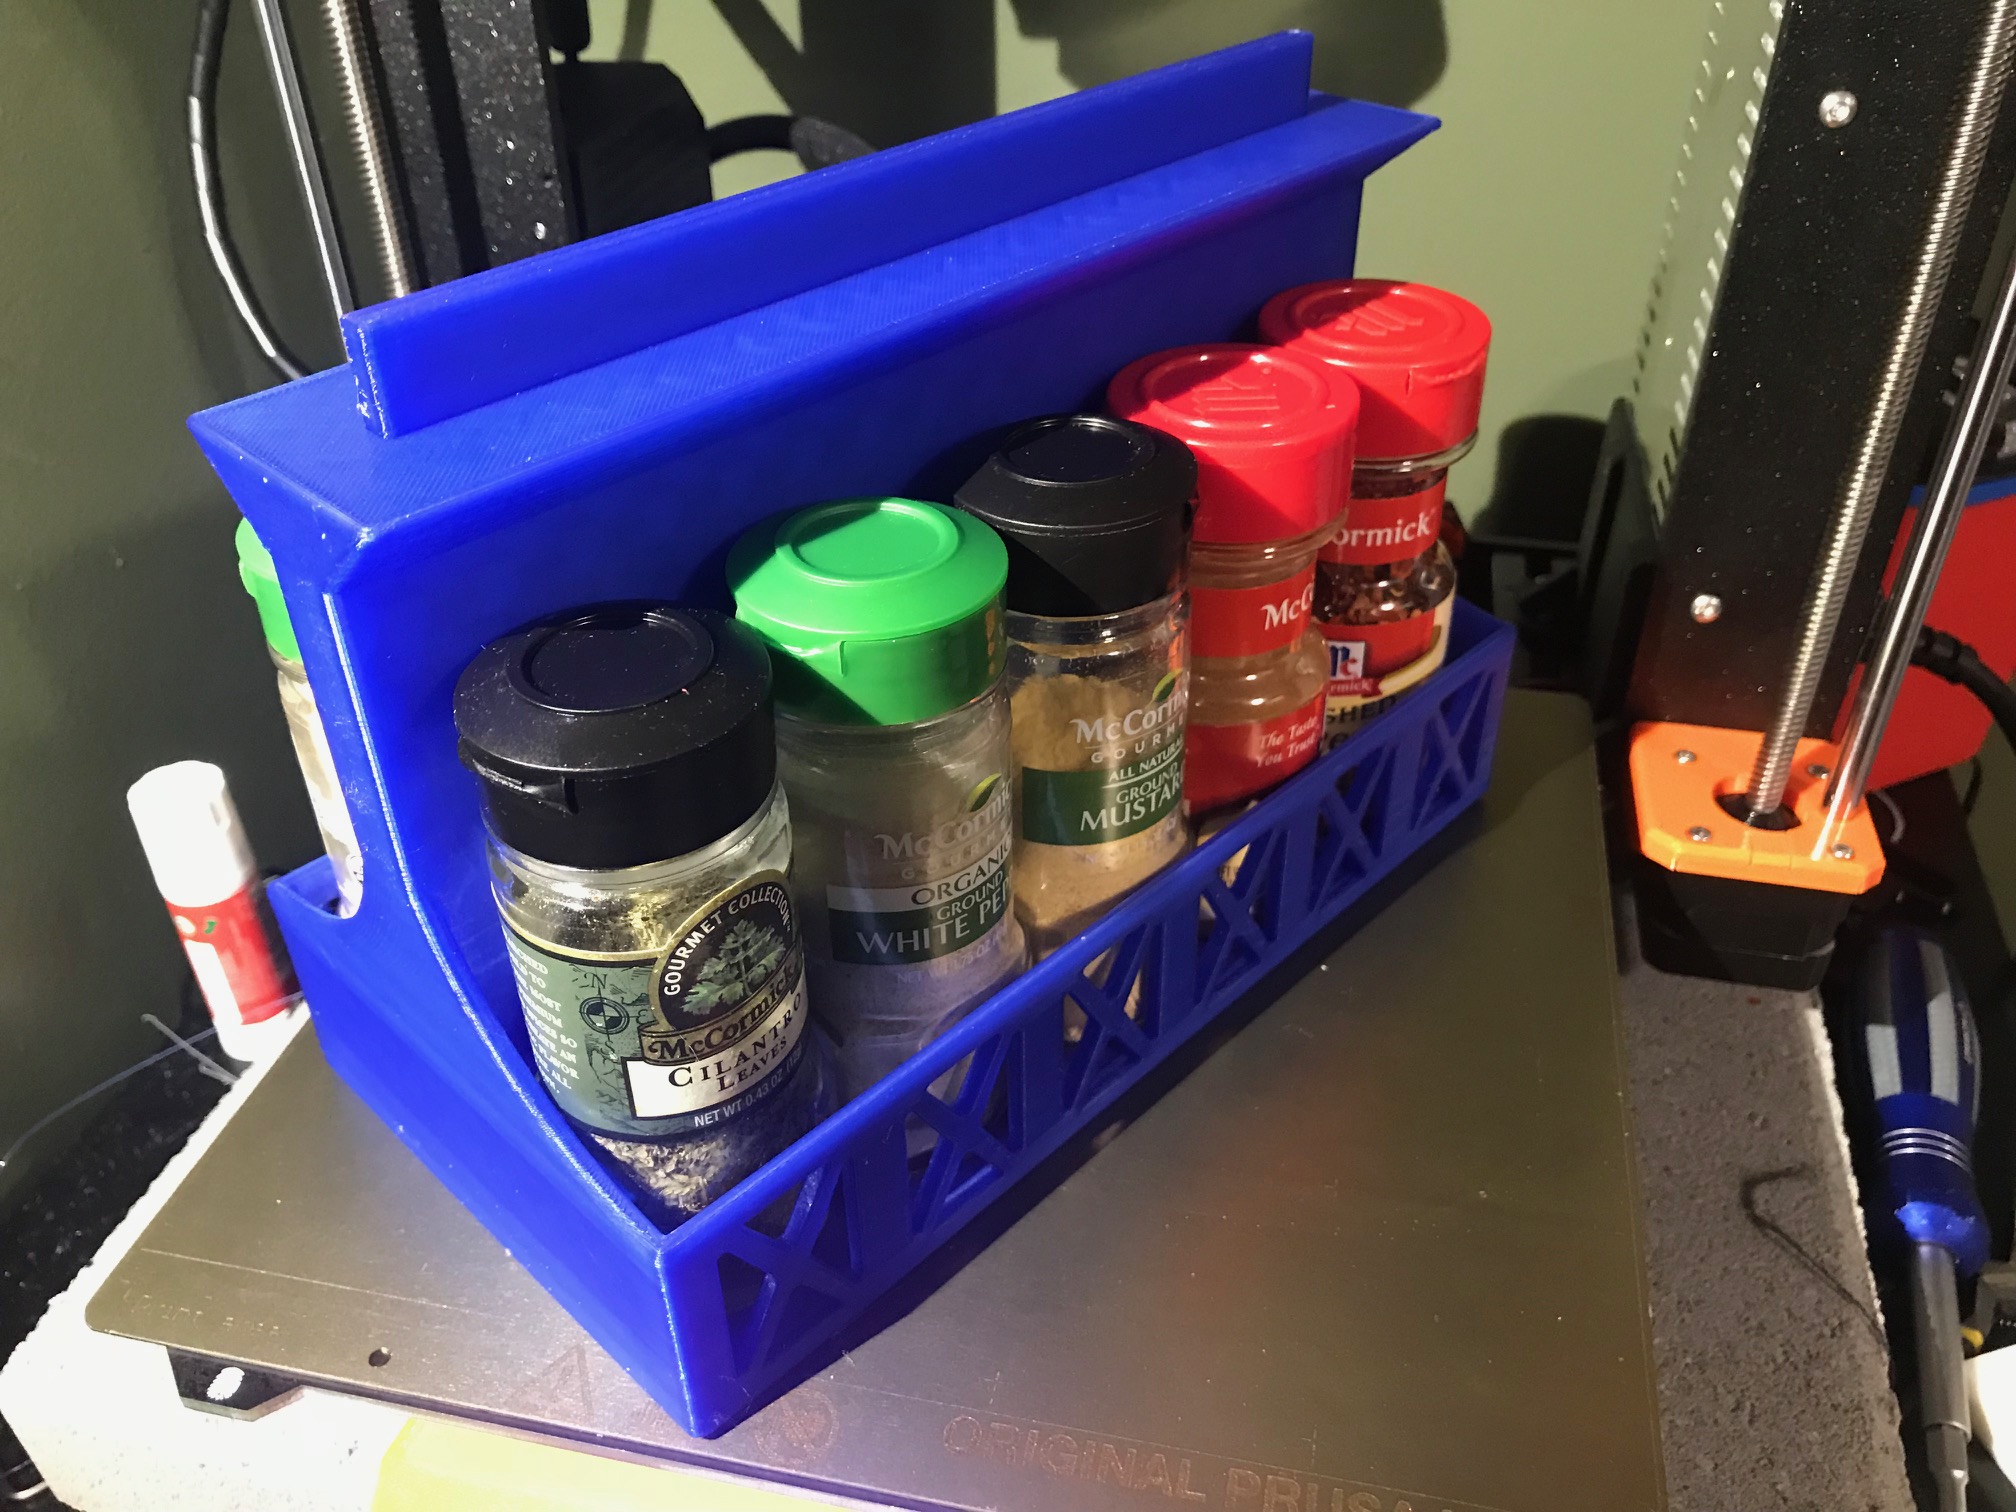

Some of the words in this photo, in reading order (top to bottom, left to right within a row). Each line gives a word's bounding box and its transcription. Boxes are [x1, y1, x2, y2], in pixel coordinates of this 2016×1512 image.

[1256, 752, 1282, 767] You
[1260, 730, 1284, 749] The
[1108, 767, 1135, 782] ALL
[1116, 762, 1178, 803] GROUND
[936, 870, 1003, 920] GROUND
[664, 910, 723, 996] GOURMET
[728, 885, 791, 927] COLLECTION
[856, 913, 970, 954] WHITE
[529, 971, 546, 989] TO
[530, 985, 561, 1012] MOST
[648, 964, 797, 1060] McCormick
[668, 992, 801, 1087] CILANTRO
[717, 1036, 786, 1092] LEAVES
[694, 1109, 720, 1127] NET
[723, 1099, 742, 1117] WT
[745, 1083, 769, 1106] 0.43
[771, 1070, 783, 1087] OZ
[942, 1415, 1206, 1501] ORIGINAL
